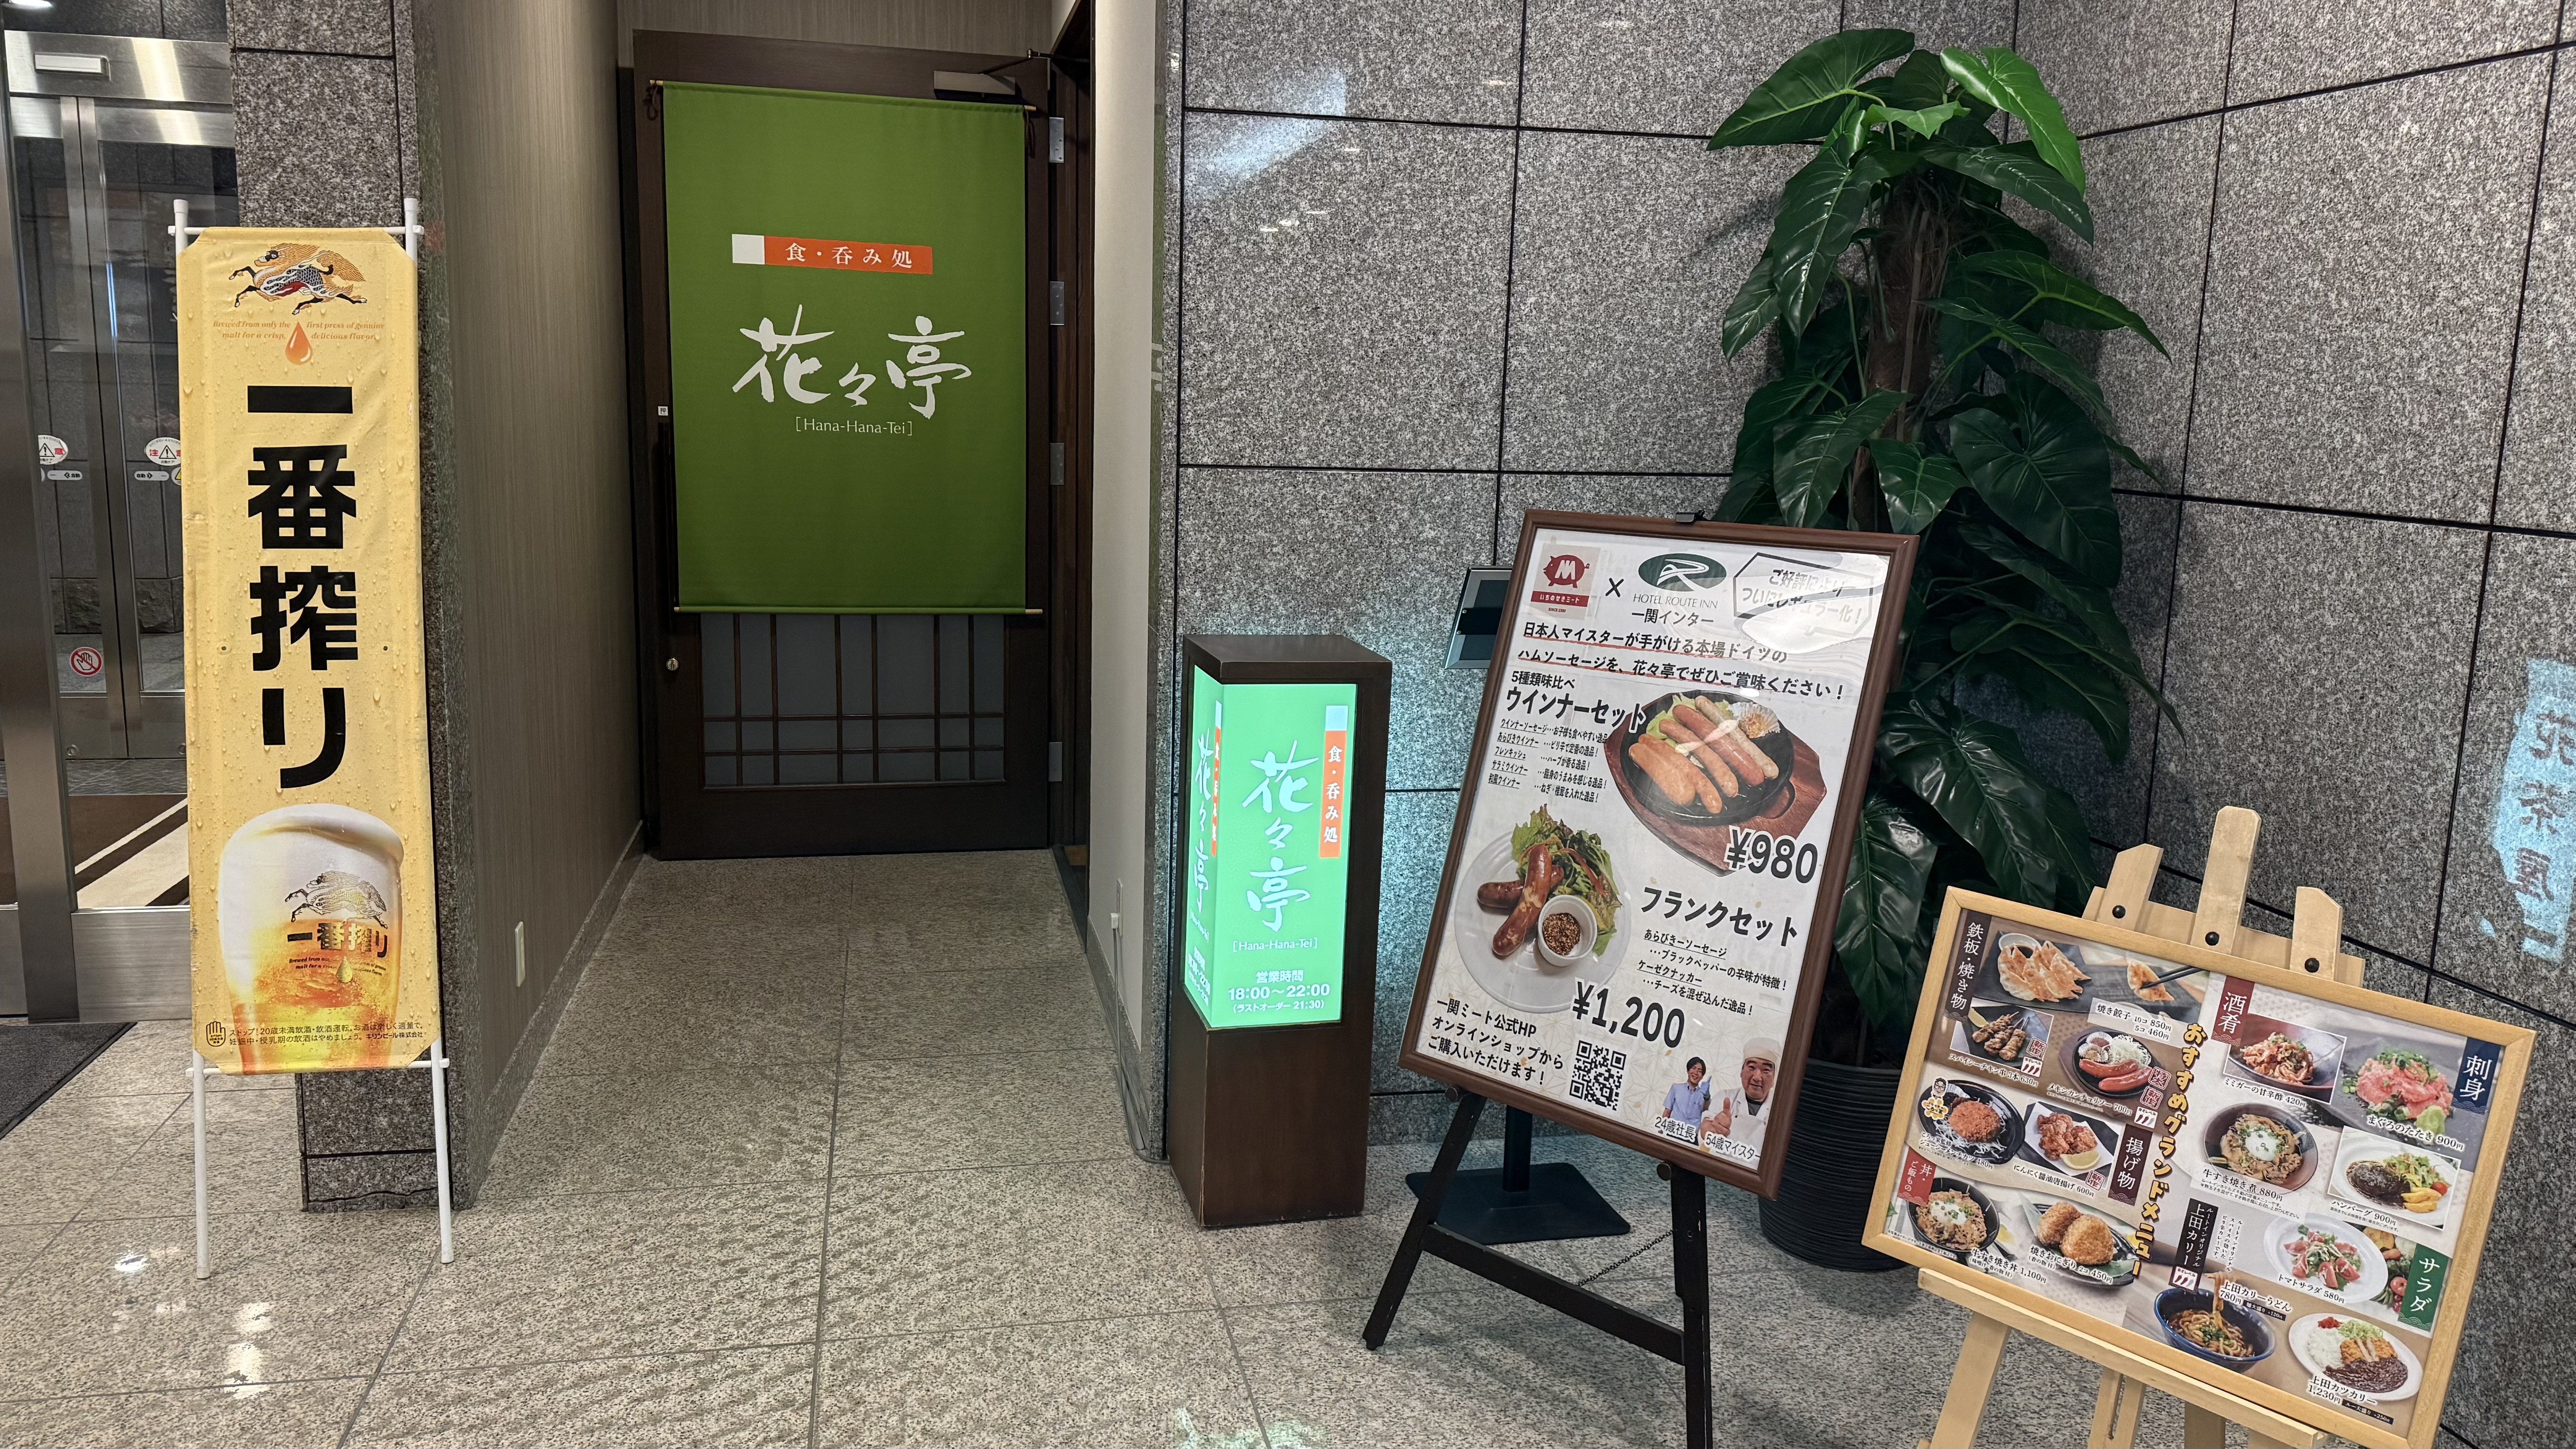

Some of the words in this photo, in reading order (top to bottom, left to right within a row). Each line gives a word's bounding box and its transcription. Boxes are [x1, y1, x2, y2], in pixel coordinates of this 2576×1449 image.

[785, 242, 912, 268] 食・呑み処
[264, 332, 286, 340] crisp,
[732, 304, 972, 420] 花々亭
[796, 416, 912, 436] [Hana-Hana-Tei]
[248, 386, 358, 789] 一番搾り
[1540, 594, 1580, 604] いちのせきミート
[1633, 593, 1663, 604] HOTEL
[1665, 596, 1698, 607] ROUTE
[1699, 598, 1718, 609] INN
[1632, 608, 1714, 626] 一関インター
[1524, 621, 1787, 663] 日本人マイスターが手がける本場ドイツの
[1511, 671, 1575, 689] 5種類味比べ
[1518, 649, 1843, 700] ハムソーセージを、花々亭でぜひご賞味ください！
[1507, 686, 1645, 731] ウインナーセット
[1497, 731, 1539, 744] あらびきウインナー
[1492, 760, 1528, 773] サラミウインナー
[1323, 745, 1343, 843] 食・呑み処
[1242, 739, 1320, 933] 花々亭
[1727, 829, 1818, 884] ¥980
[1641, 887, 1798, 947] フランクセット
[287, 922, 388, 958] 一番搾り
[1233, 937, 1318, 952] [Hana-Hana-Tei]
[1644, 928, 1727, 957] あらびきーソーセージ
[1256, 970, 1304, 984] 営業時間
[1638, 960, 1703, 983] ケーゼクナッカー
[1950, 922, 1984, 1010] 鉄板・焼き物
[1293, 999, 1325, 1010] 21:30)
[1437, 998, 1537, 1038] 一関ミート公式HP
[1572, 981, 1685, 1048] ¥1,200
[2097, 1003, 2131, 1020] 焼き餃子
[2134, 1016, 2148, 1025] 10コ
[2150, 1017, 2171, 1032] 850円
[2217, 991, 2247, 1034] 酒肴
[1432, 1016, 1564, 1069] オンラインショップから
[2148, 1028, 2169, 1040] 460円
[1428, 1035, 1545, 1086] ご購入いただけます！
[2459, 1055, 2493, 1101] 刺身
[2047, 1083, 2112, 1108] メキシカンチョリソー
[2114, 1104, 2133, 1116] 700円
[2285, 1096, 2306, 1108] 420円
[1655, 1116, 1696, 1141] 24歳社長
[2367, 1115, 2434, 1141] まぐろのたたき
[2437, 1135, 2464, 1151] 900円
[1706, 1133, 1761, 1160] 54歳マイスター
[2132, 1022, 2207, 1278] おすすめグランドメニュー
[1904, 1161, 1919, 1191] ご飯もの
[2117, 1137, 2144, 1190] 揚げ物
[2014, 1164, 2075, 1190] にんにく醤油唐揚げ
[2076, 1186, 2094, 1197] 600円
[2203, 1168, 2257, 1193] 牛すき焼き煮
[2259, 1187, 2283, 1202] 880円
[2331, 1201, 2373, 1216] ハンバーグ
[2374, 1212, 2397, 1226] 900円
[2183, 1203, 2205, 1265] 上田カリー
[2193, 1207, 2214, 1267] ルートインオリジナル
[1971, 1248, 2018, 1272] 牛すき焼き丼
[2020, 1267, 2047, 1283] 1,100円
[2030, 1246, 2076, 1269] 焼きおにぎり
[2091, 1269, 2112, 1283] 450円
[2220, 1289, 2242, 1305] 780円
[2221, 1281, 2292, 1312] 上田カリーうどん
[2278, 1273, 2322, 1294] トマトサラダ
[2323, 1289, 2345, 1304] 580円
[2410, 1257, 2440, 1312] サラダ
[2308, 1385, 2341, 1405] 1,230円
[2310, 1375, 2377, 1404] 上田カツカリー
